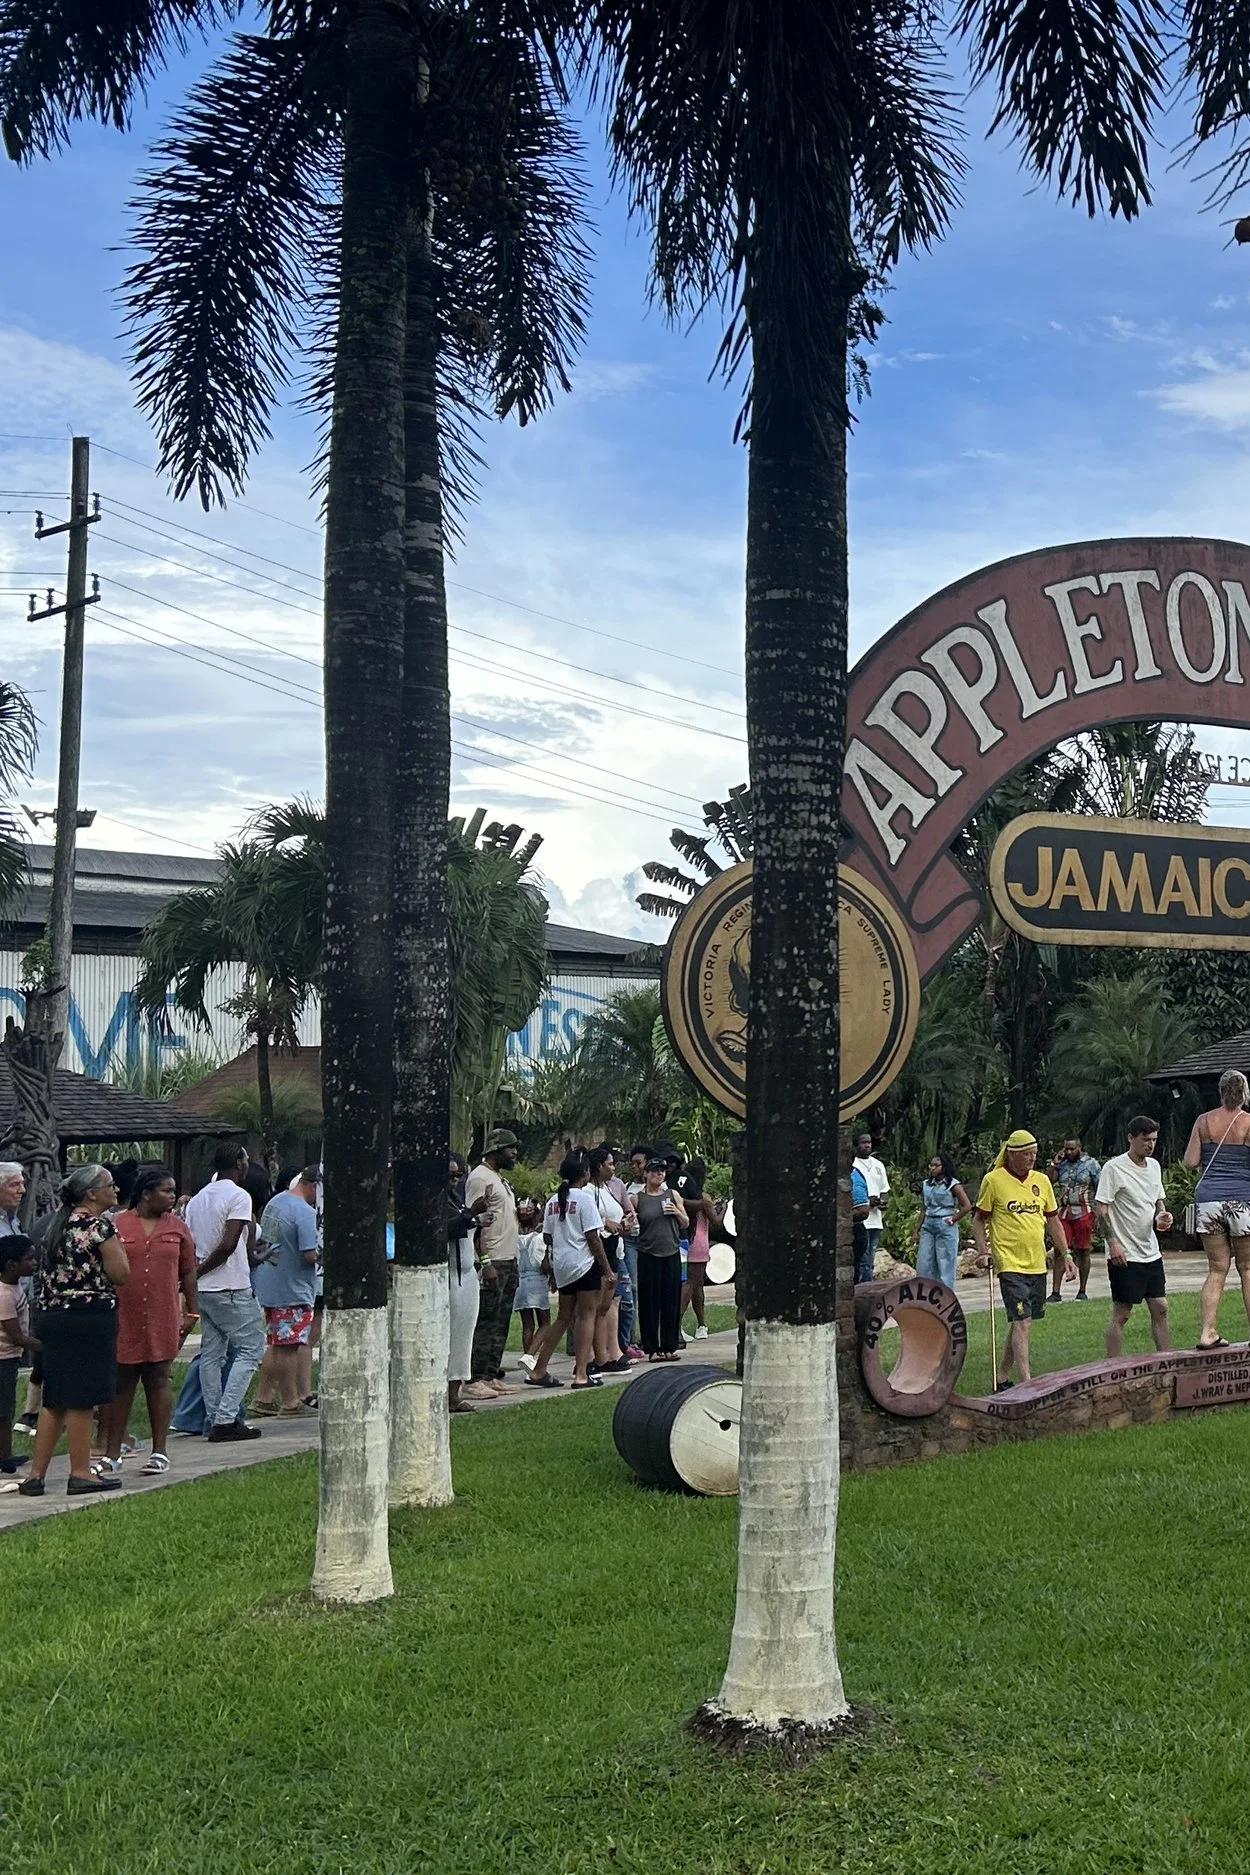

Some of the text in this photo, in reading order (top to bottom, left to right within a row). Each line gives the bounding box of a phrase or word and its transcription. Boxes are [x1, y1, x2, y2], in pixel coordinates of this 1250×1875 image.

[704, 943, 722, 1018] VICTORIA
[722, 901, 752, 932] REGIN
[857, 918, 888, 969] SUPREME
[882, 980, 891, 1016] LADY
[548, 1201, 577, 1216] BRDE
[1007, 1200, 1040, 1214] Carlsberg
[865, 1296, 894, 1349] 40%
[987, 1403, 1009, 1416] OLD
[1025, 1390, 1066, 1411] OPPER
[1070, 1374, 1106, 1393] STILL
[1110, 1368, 1127, 1380] ON
[1132, 1363, 1153, 1375] THE
[1227, 1386, 1234, 1396] &
